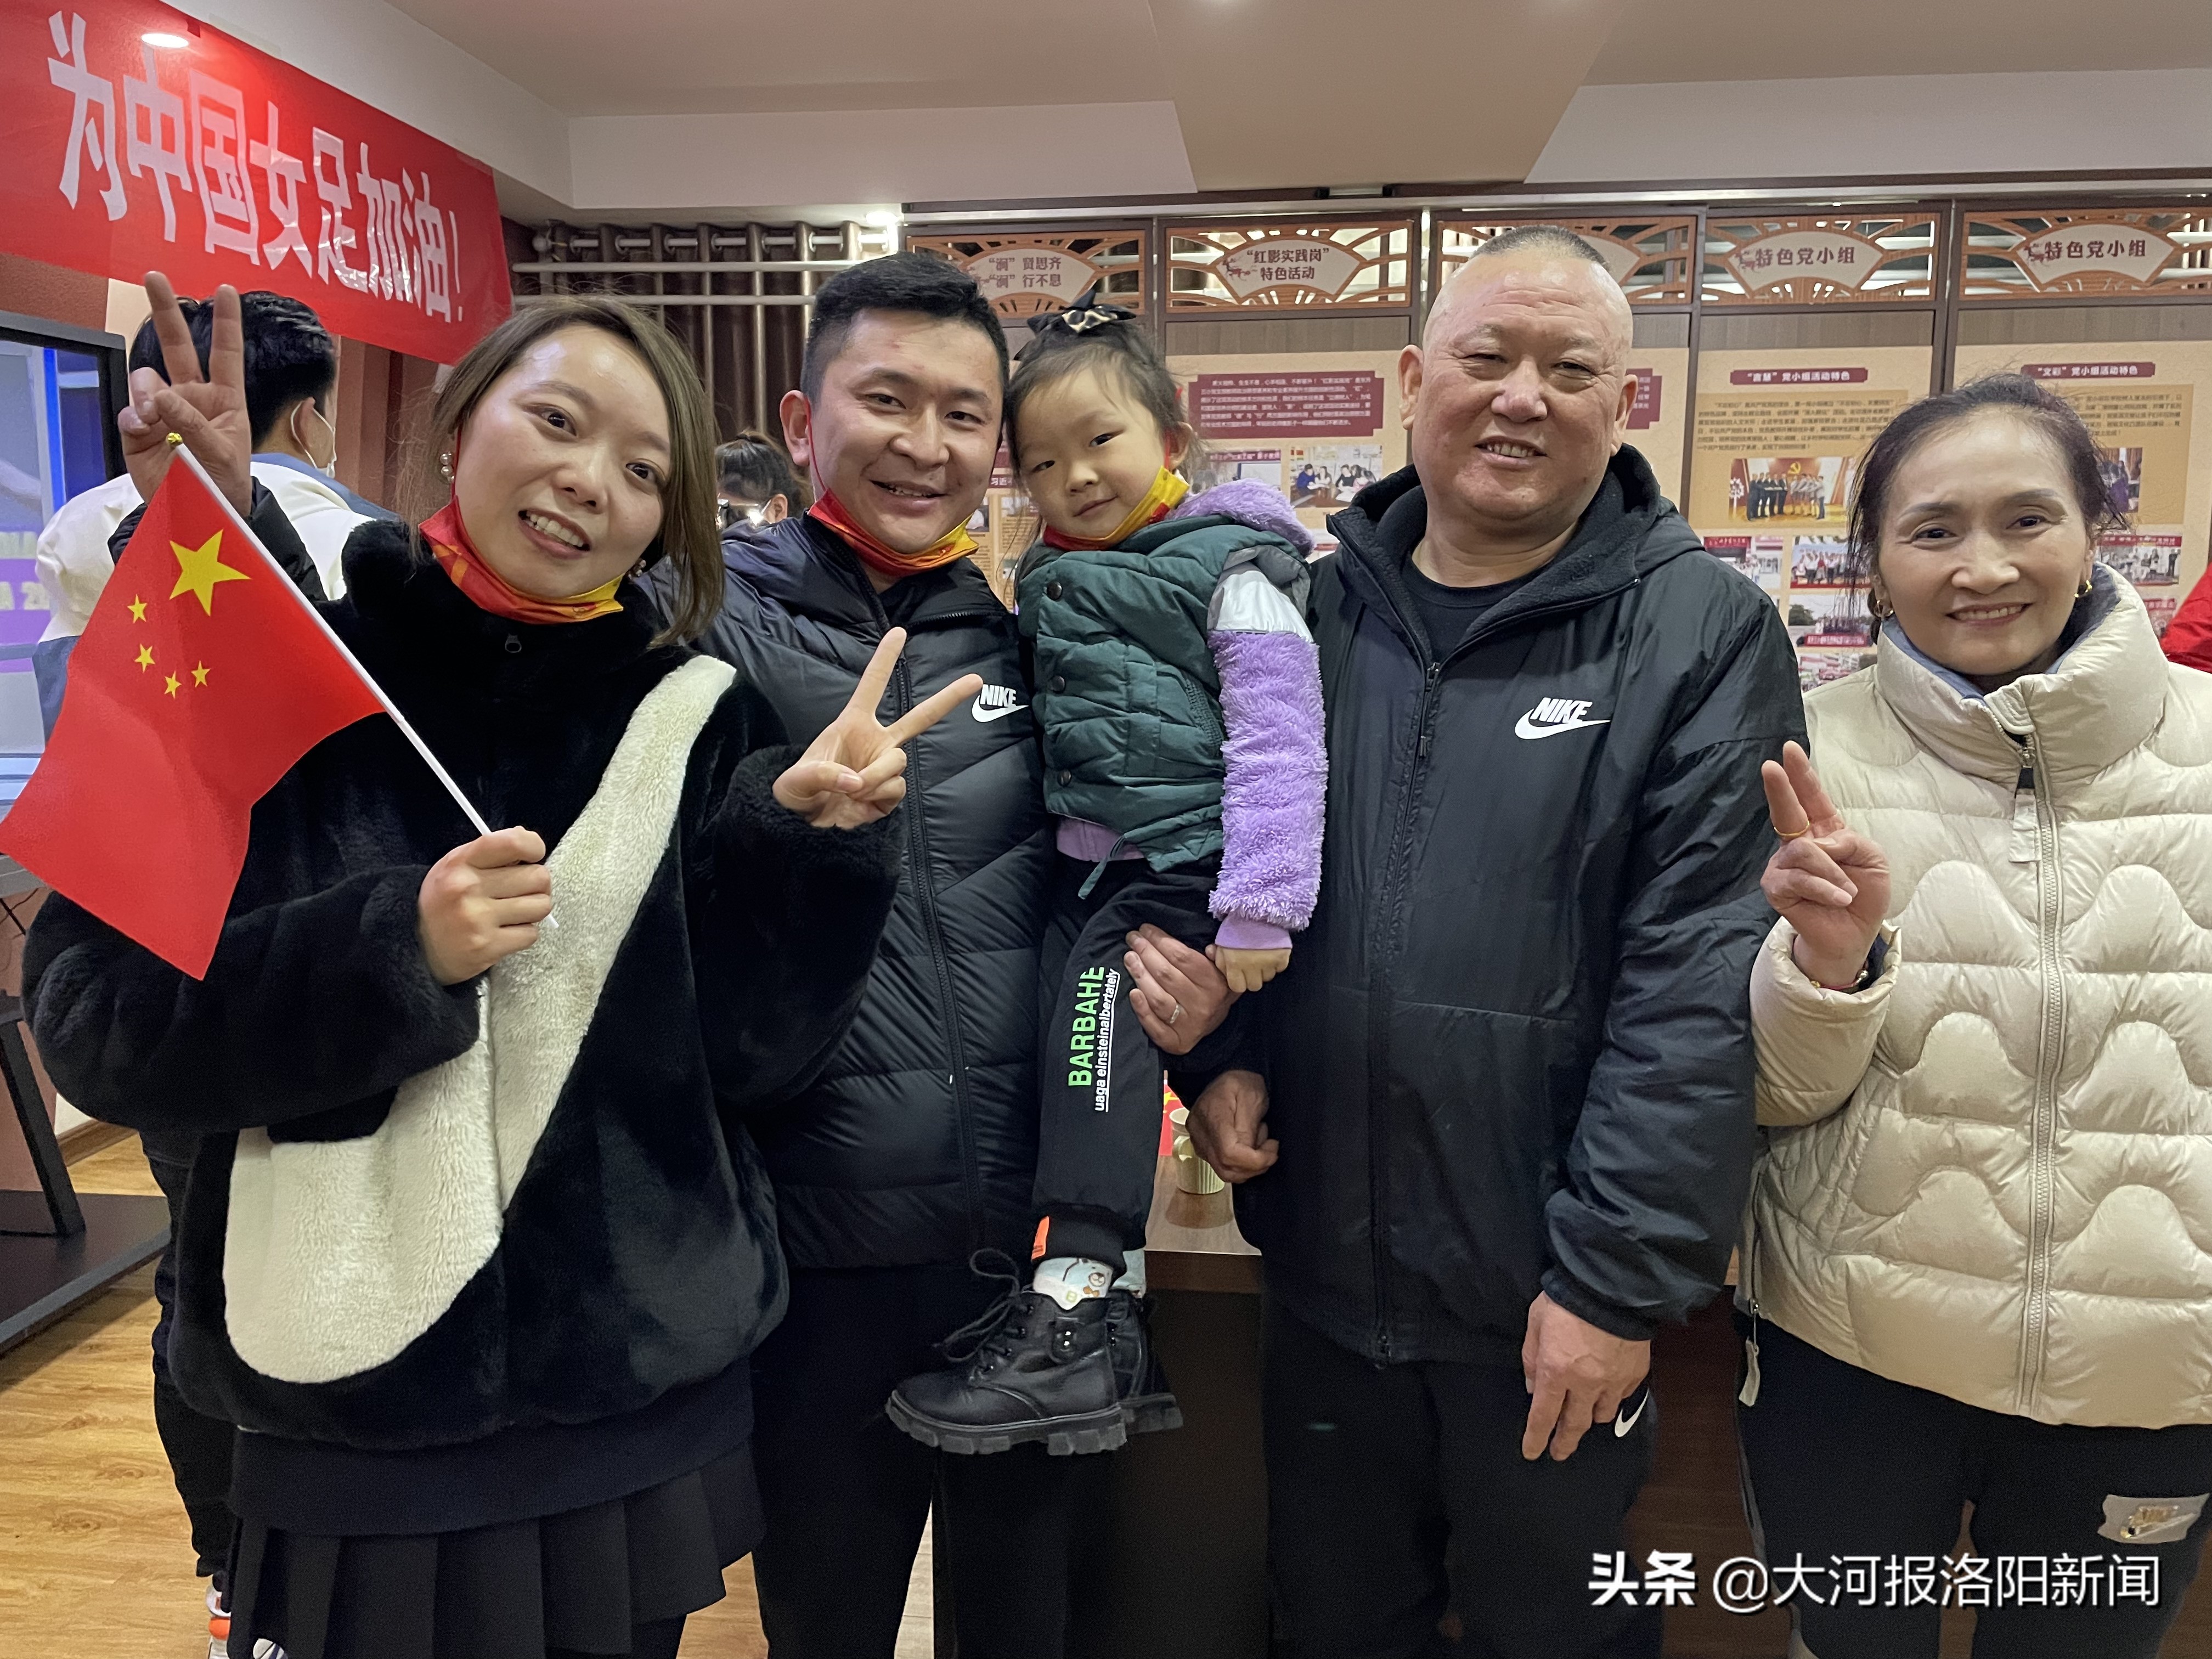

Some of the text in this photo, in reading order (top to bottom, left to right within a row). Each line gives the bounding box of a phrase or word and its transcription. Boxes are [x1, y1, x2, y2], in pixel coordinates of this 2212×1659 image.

[1246, 247, 1330, 262] “红影实践岗”
[1756, 247, 1855, 266] 特色党小组
[2045, 240, 2146, 259] 特色党小组
[1261, 267, 1315, 281] 特色活动
[980, 684, 1017, 707] NIKE
[1530, 697, 1593, 723] NIKE
[1068, 967, 1104, 1086] BARBAHE
